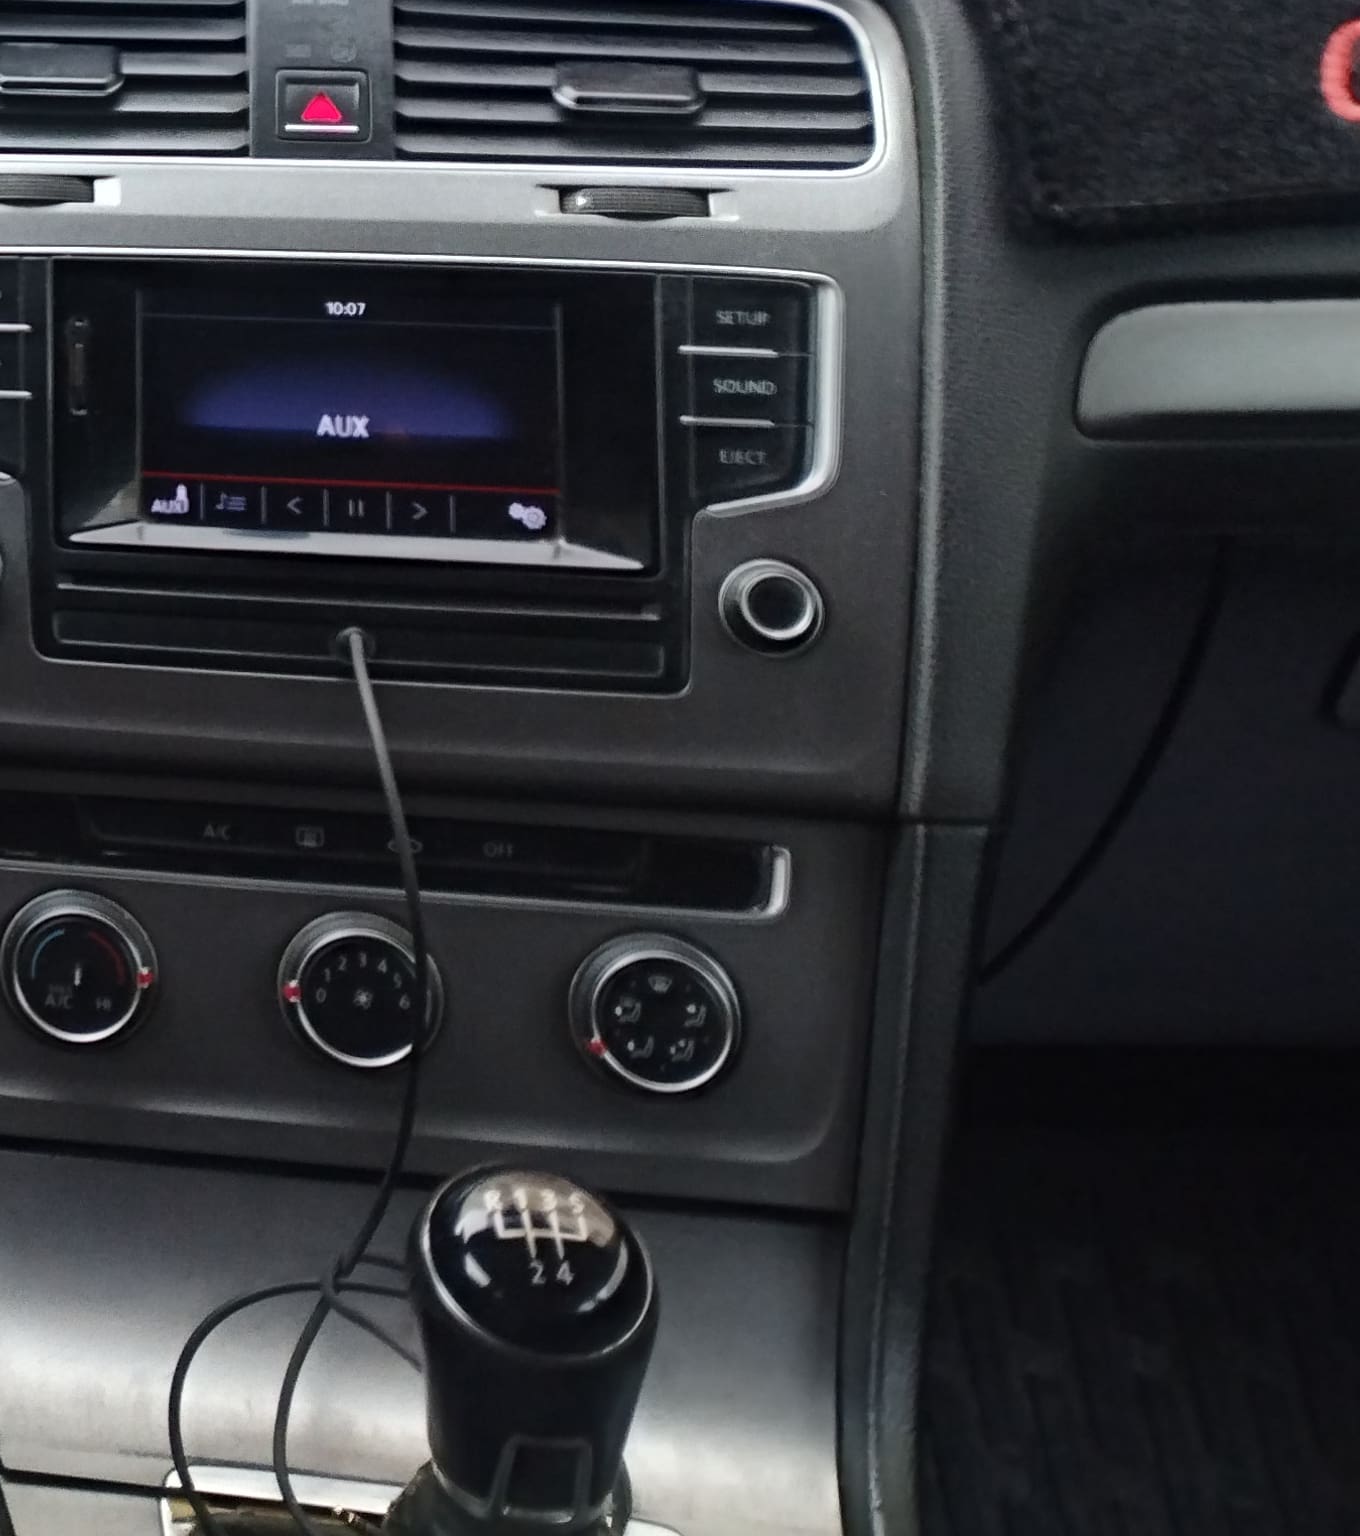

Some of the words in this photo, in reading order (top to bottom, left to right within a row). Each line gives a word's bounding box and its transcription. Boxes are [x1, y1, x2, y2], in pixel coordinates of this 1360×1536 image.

[325, 301, 366, 316] 10:07
[716, 310, 771, 326] SETUP
[713, 378, 777, 395] SOUND
[316, 413, 371, 439] AUX
[719, 449, 768, 465] EJECT
[529, 1259, 547, 1285] 2
[556, 1260, 575, 1286] 4
